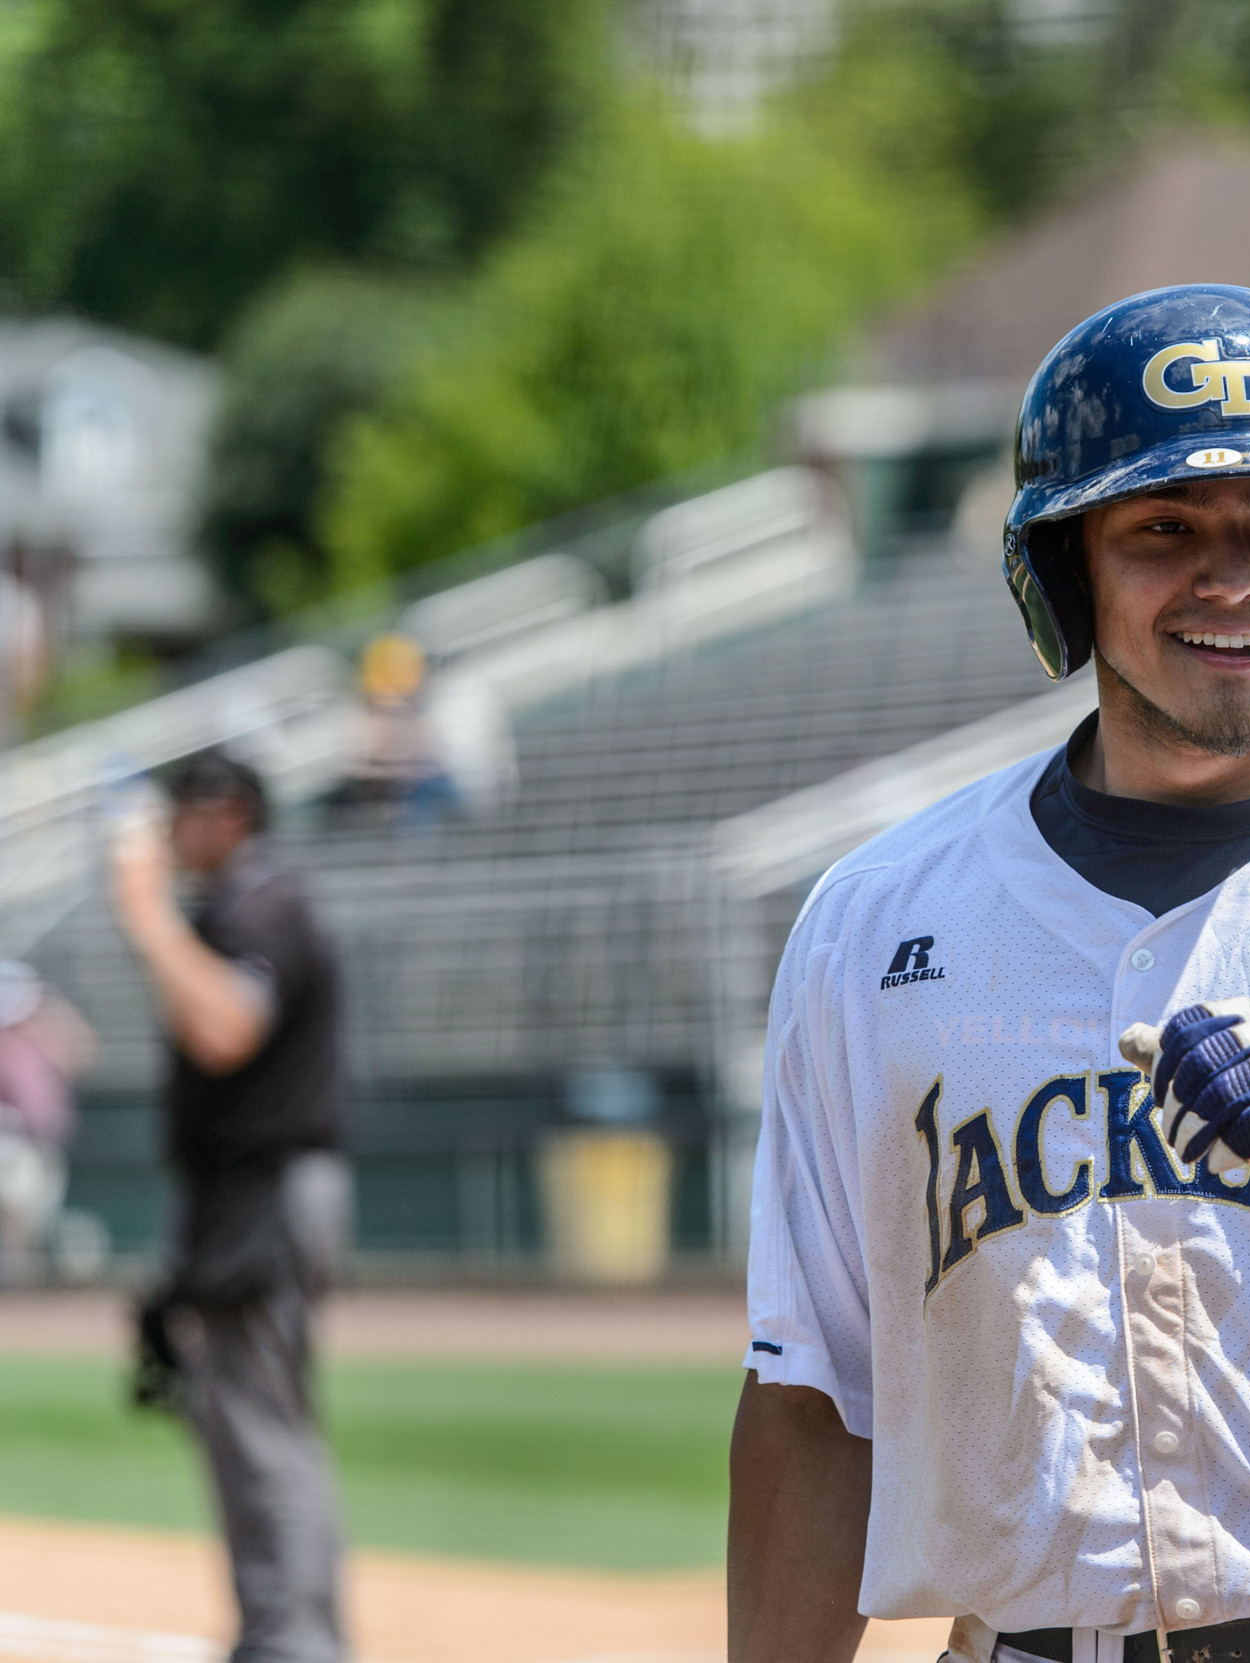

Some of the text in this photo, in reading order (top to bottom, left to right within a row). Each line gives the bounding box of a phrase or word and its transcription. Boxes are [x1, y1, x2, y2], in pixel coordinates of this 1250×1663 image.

[1203, 451, 1226, 464] 11
[880, 967, 946, 990] RUSSELL
[933, 1013, 1112, 1047] YELLO
